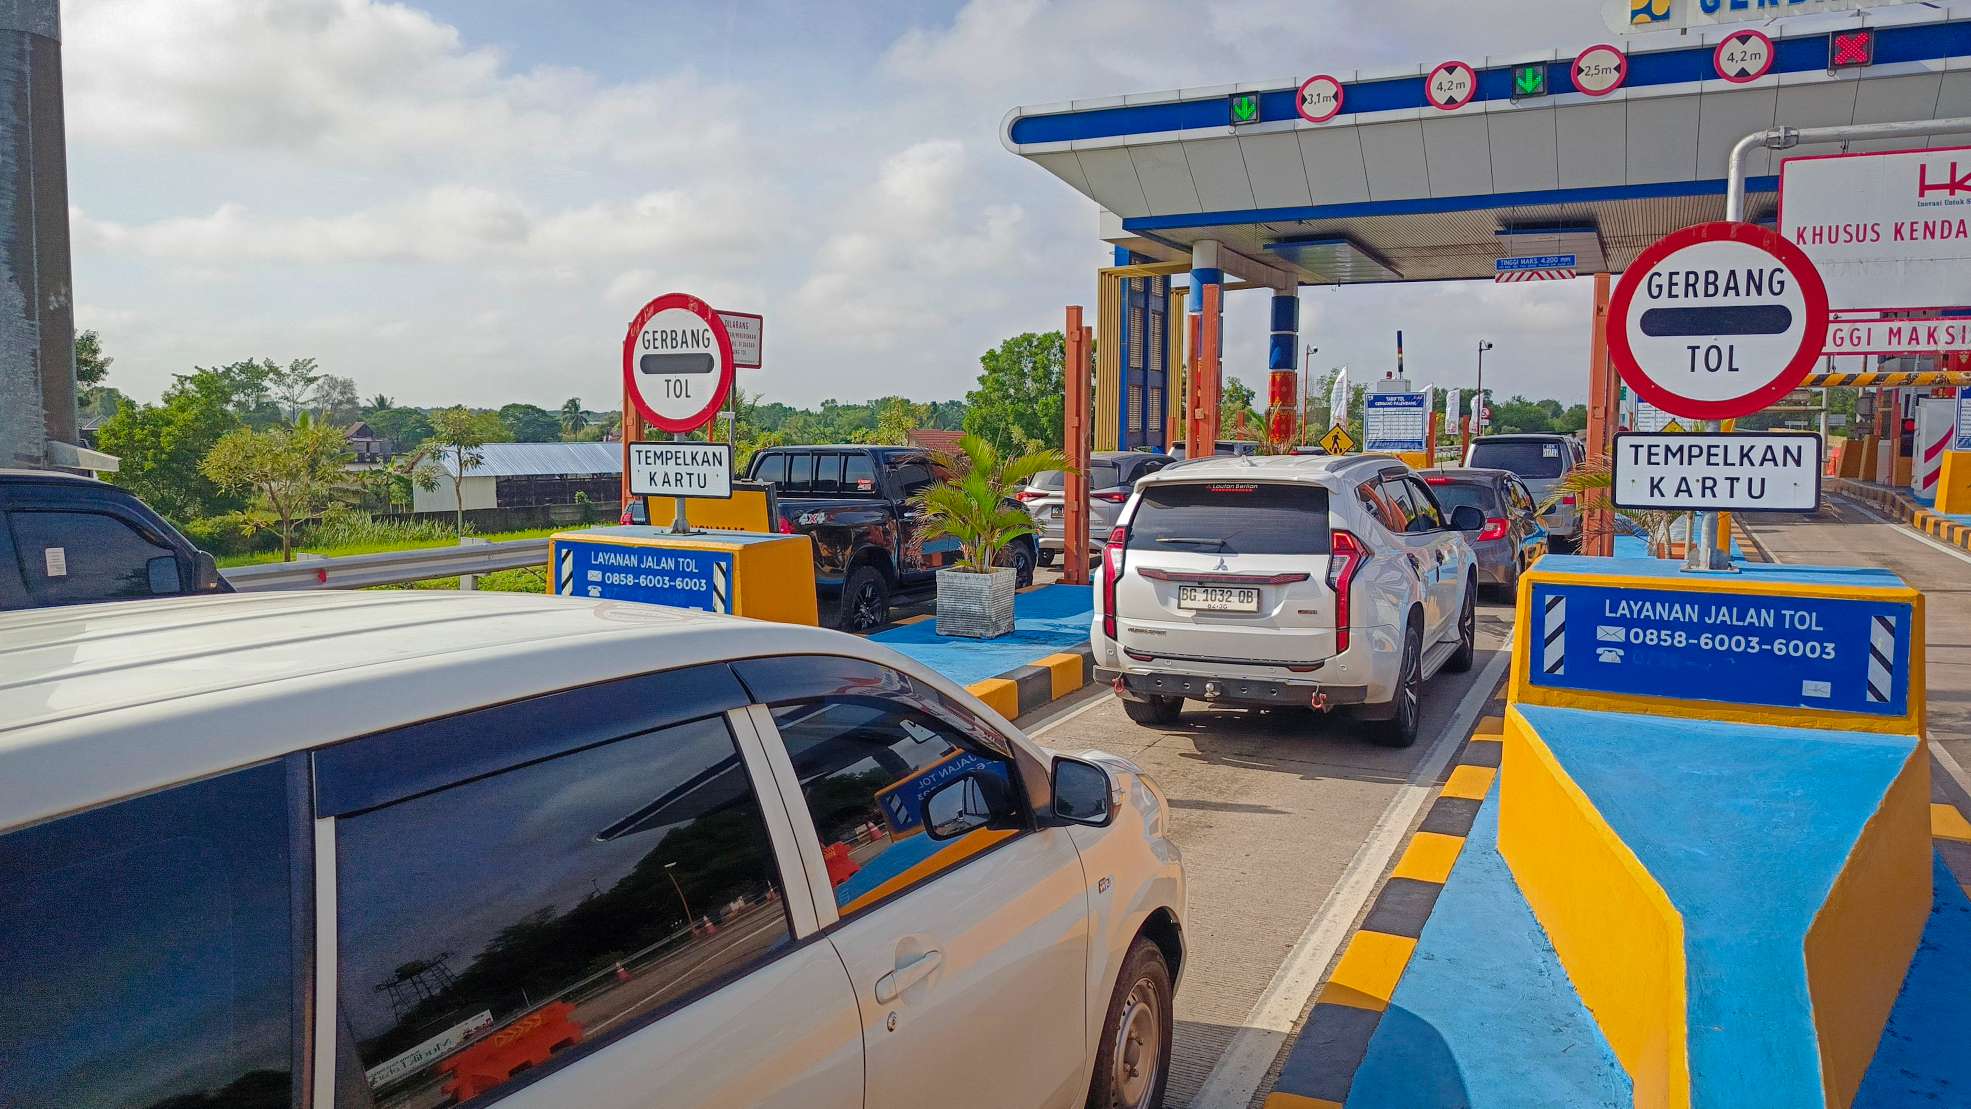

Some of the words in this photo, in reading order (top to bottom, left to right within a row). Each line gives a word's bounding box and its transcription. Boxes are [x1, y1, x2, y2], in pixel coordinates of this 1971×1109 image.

[1796, 222, 1881, 246] KHUSUS
[1894, 218, 1968, 242] KENDA
[1646, 267, 1786, 300] GERBANG
[642, 328, 711, 350] GERBANG
[1887, 325, 1967, 347] MAKSI
[1686, 344, 1739, 373] TOL
[664, 378, 692, 399] TOL
[636, 449, 723, 467] TEMPELKAN
[1629, 443, 1803, 468] TEMPELKAN
[649, 471, 707, 489] KARTU
[1649, 476, 1766, 500] KARTU
[591, 551, 638, 568] LAYANAN
[640, 555, 675, 571] JALAN
[677, 557, 699, 573] TOL
[604, 572, 707, 592] 0858-6003-6003
[1181, 587, 1197, 602] BG
[1202, 588, 1233, 603] 1032
[1605, 599, 1699, 623] LAYANAN
[1704, 605, 1775, 629] JALAN
[1781, 609, 1824, 632] TOL
[1629, 627, 1836, 660] 0858-6003-6003
